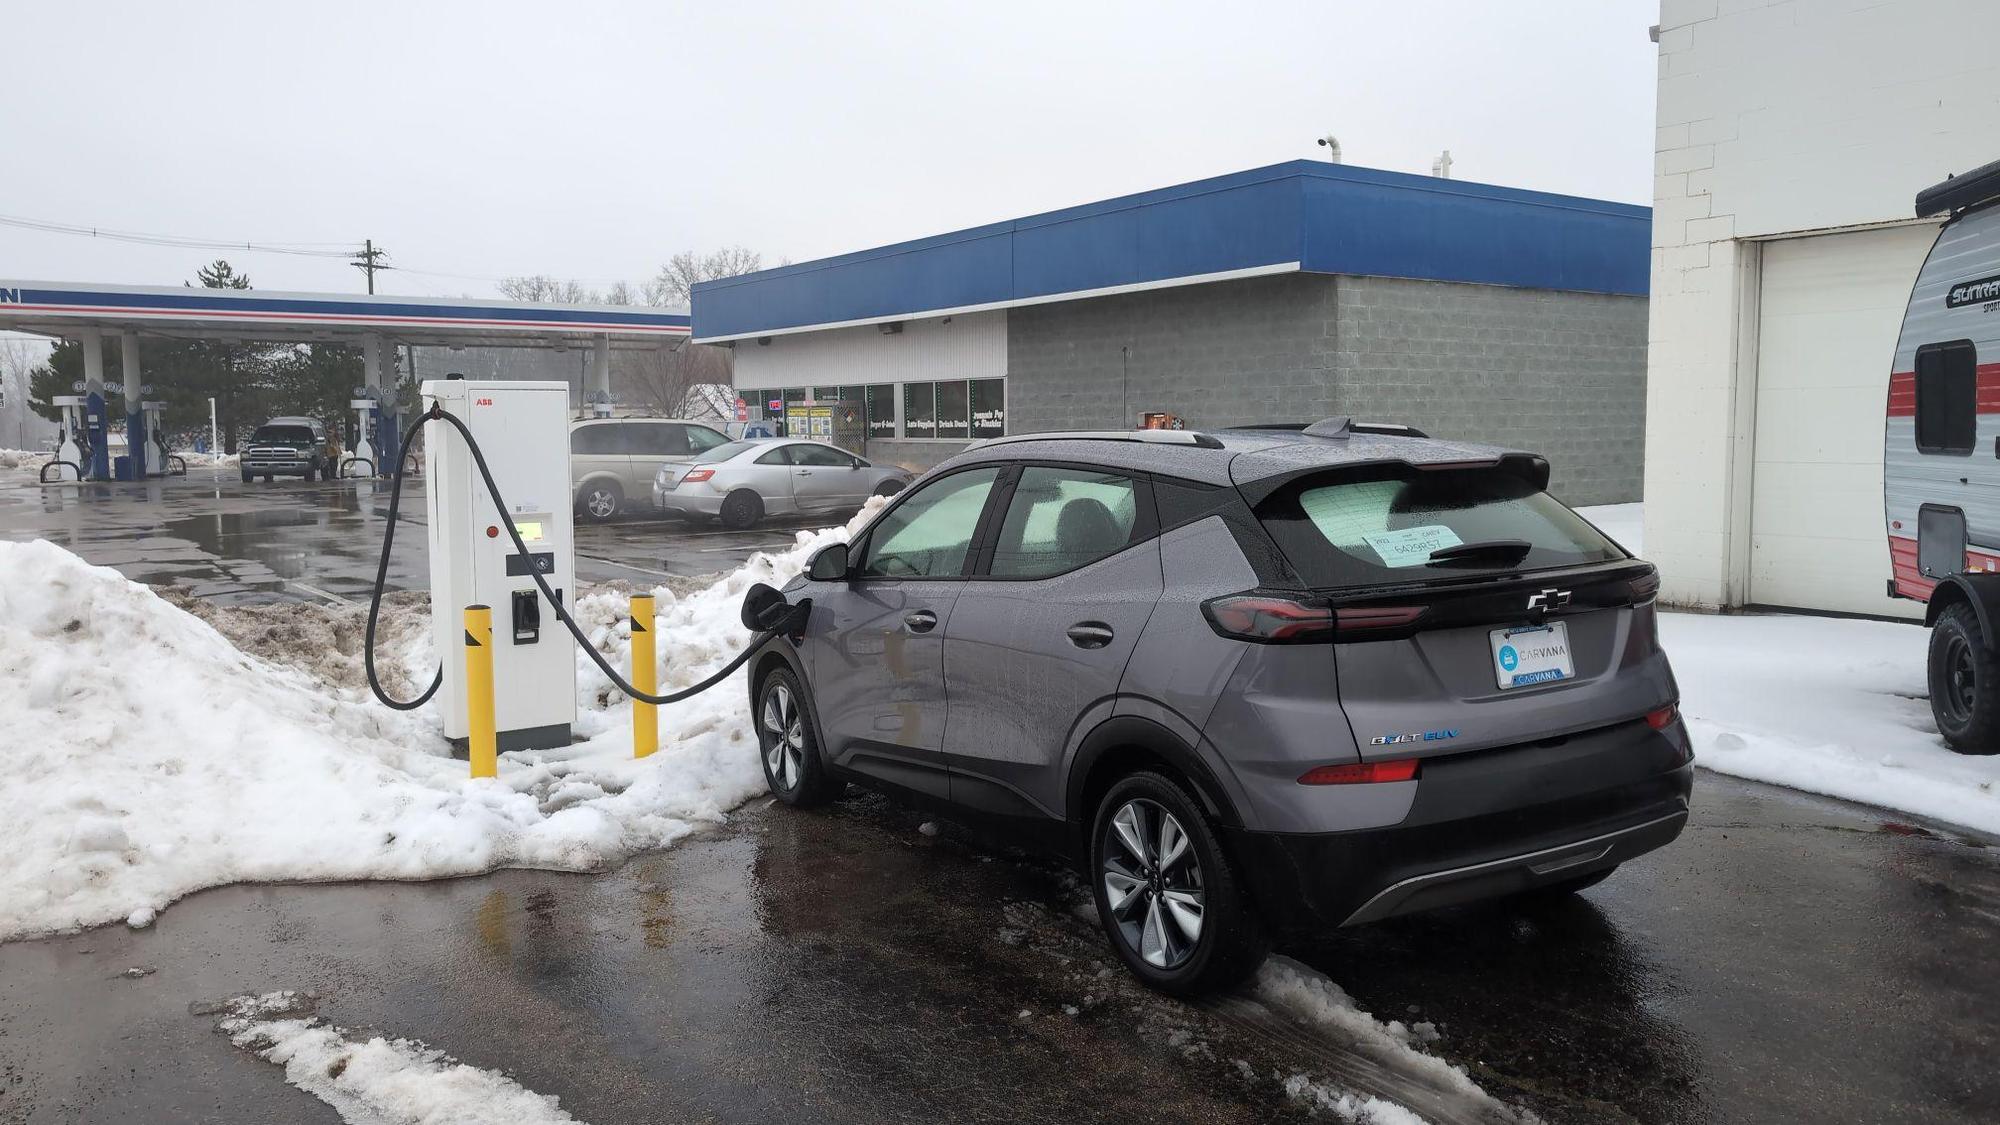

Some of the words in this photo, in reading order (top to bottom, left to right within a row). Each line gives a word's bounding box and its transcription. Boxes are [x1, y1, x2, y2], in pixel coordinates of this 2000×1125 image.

[1519, 645, 1566, 661] CARVANA
[1518, 670, 1558, 685] CARVANA
[1370, 733, 1421, 745] BOLT
[1423, 728, 1461, 741] EUV
